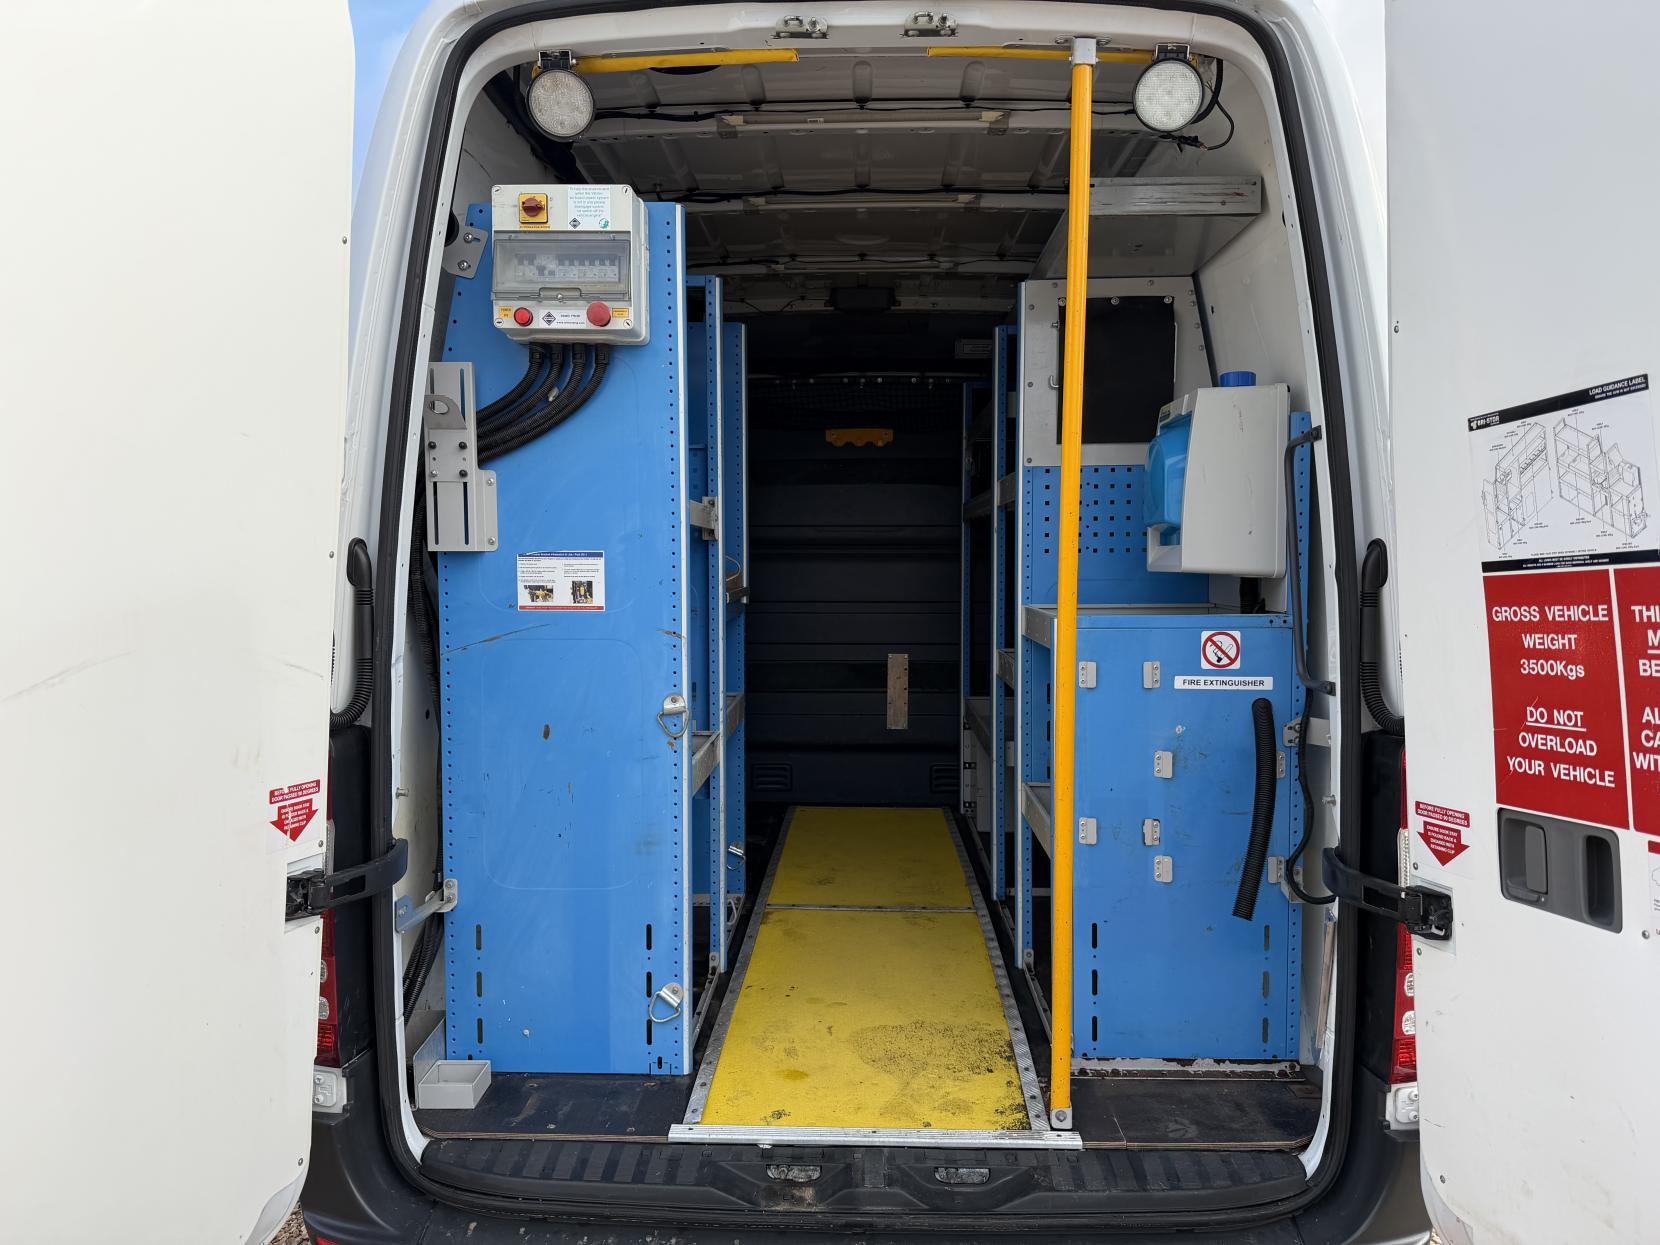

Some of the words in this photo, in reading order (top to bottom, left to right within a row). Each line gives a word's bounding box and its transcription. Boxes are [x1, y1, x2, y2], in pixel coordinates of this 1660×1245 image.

[1603, 380, 1628, 392] GUIDANCE
[1629, 376, 1645, 386] LABEL
[1492, 606, 1540, 622] GROSS
[1545, 605, 1609, 622] VEHICLE
[1522, 633, 1577, 650] WEIGHT
[1520, 659, 1585, 680] 3500Kgs
[1203, 679, 1265, 687] EXTINGUISHER
[1526, 706, 1548, 724] DO
[1553, 709, 1584, 727] NOT
[1518, 731, 1597, 757] OVERLOAD
[1507, 756, 1545, 777] YOUR
[1550, 762, 1616, 788] VEHICLE
